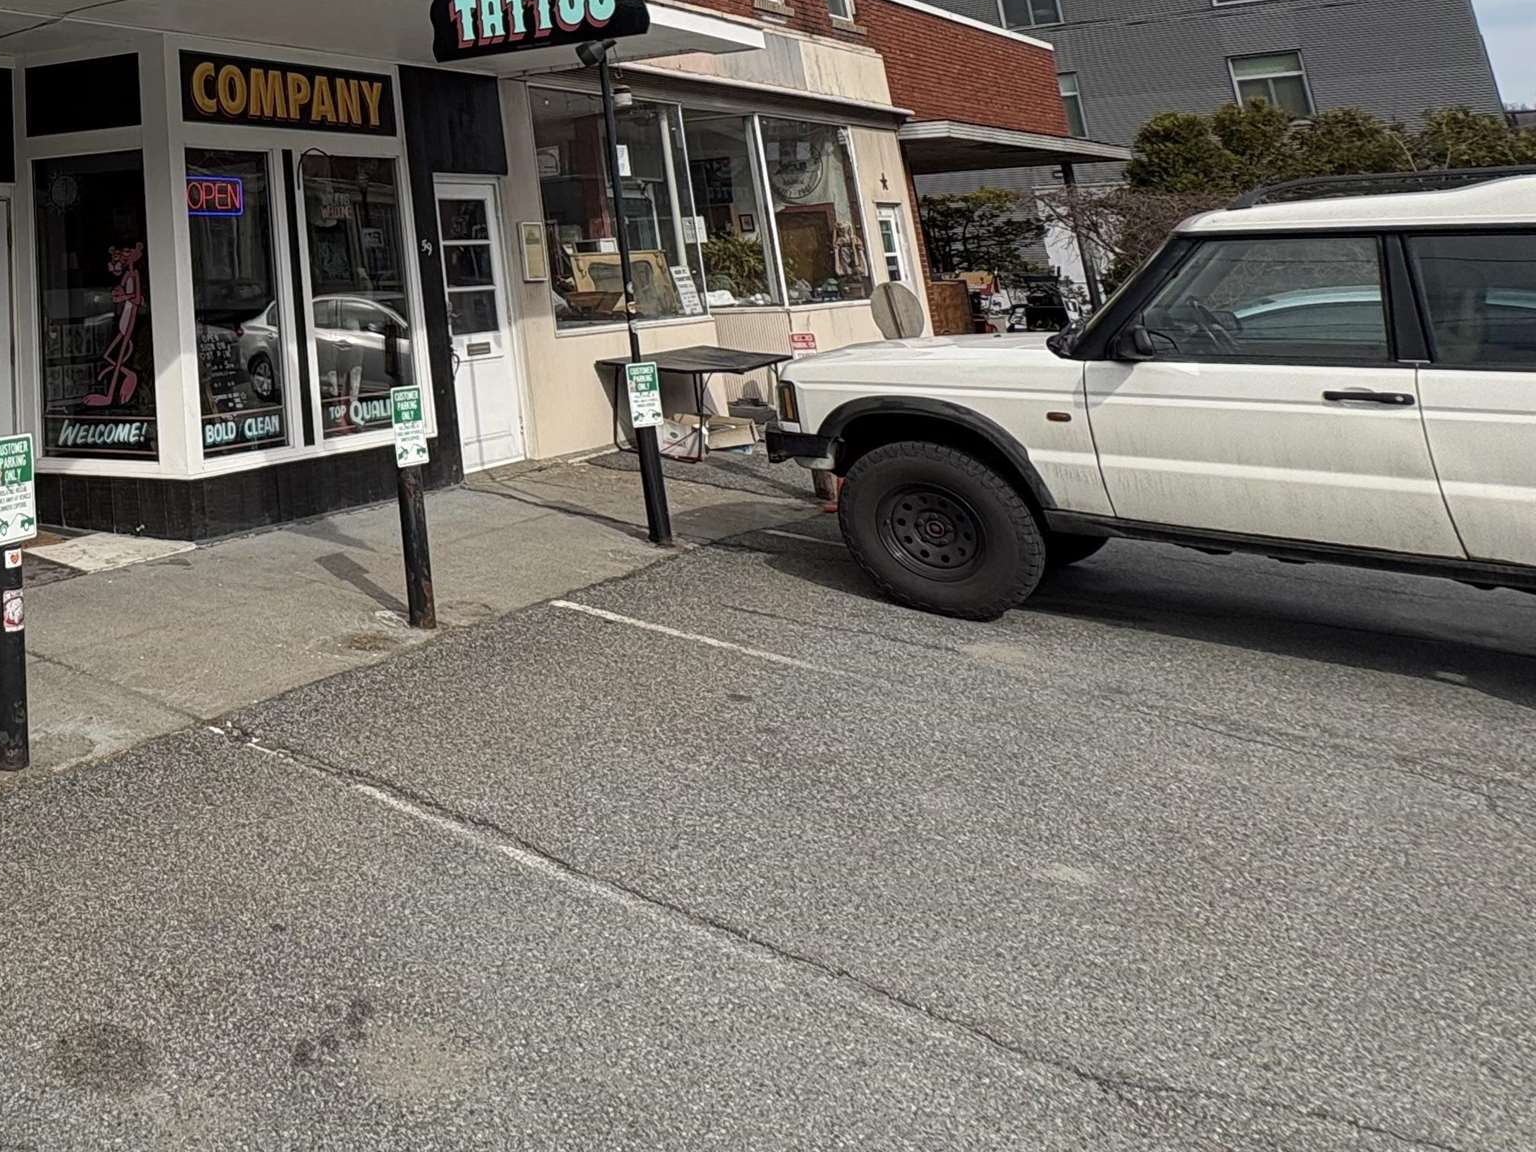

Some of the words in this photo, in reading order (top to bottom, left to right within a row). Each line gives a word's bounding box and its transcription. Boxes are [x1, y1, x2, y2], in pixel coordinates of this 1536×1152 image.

[191, 61, 382, 128] COMPANY
[187, 182, 240, 209] OPEN
[421, 239, 433, 256] 59
[328, 405, 347, 419] TOP
[350, 399, 393, 426] QUALI
[58, 419, 148, 446] WELCOME!
[205, 421, 237, 443] BOLD
[244, 415, 280, 436] CLEAN
[0, 454, 26, 469] PARKING
[5, 467, 21, 482] ONLY
